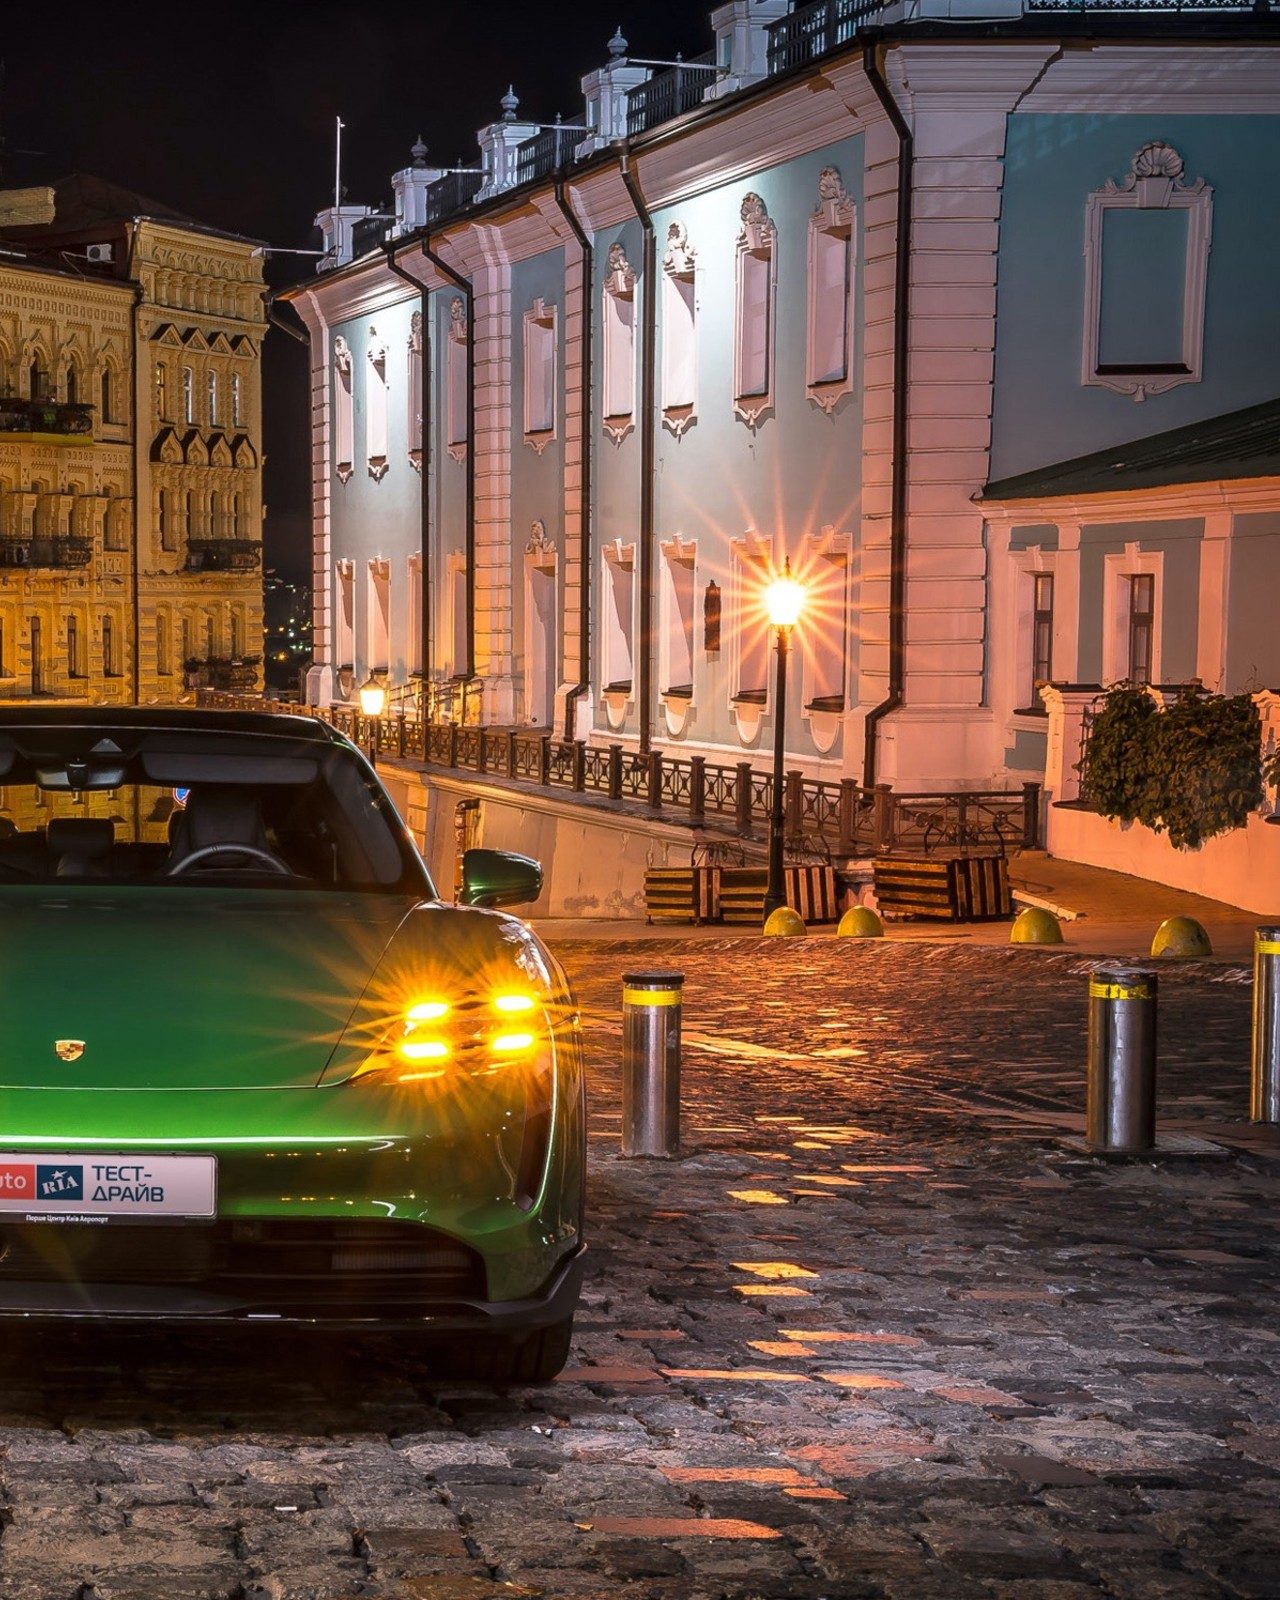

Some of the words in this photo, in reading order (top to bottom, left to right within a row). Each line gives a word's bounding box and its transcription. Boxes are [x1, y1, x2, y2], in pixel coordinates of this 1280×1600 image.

[91, 1165, 152, 1181] ТЕСТ-
[41, 1174, 80, 1195] RIA
[91, 1183, 164, 1202] ДРАЙВ
[26, 1214, 46, 1223] Порше
[47, 1215, 66, 1223] Центр
[80, 1215, 109, 1224] Аеропорт
